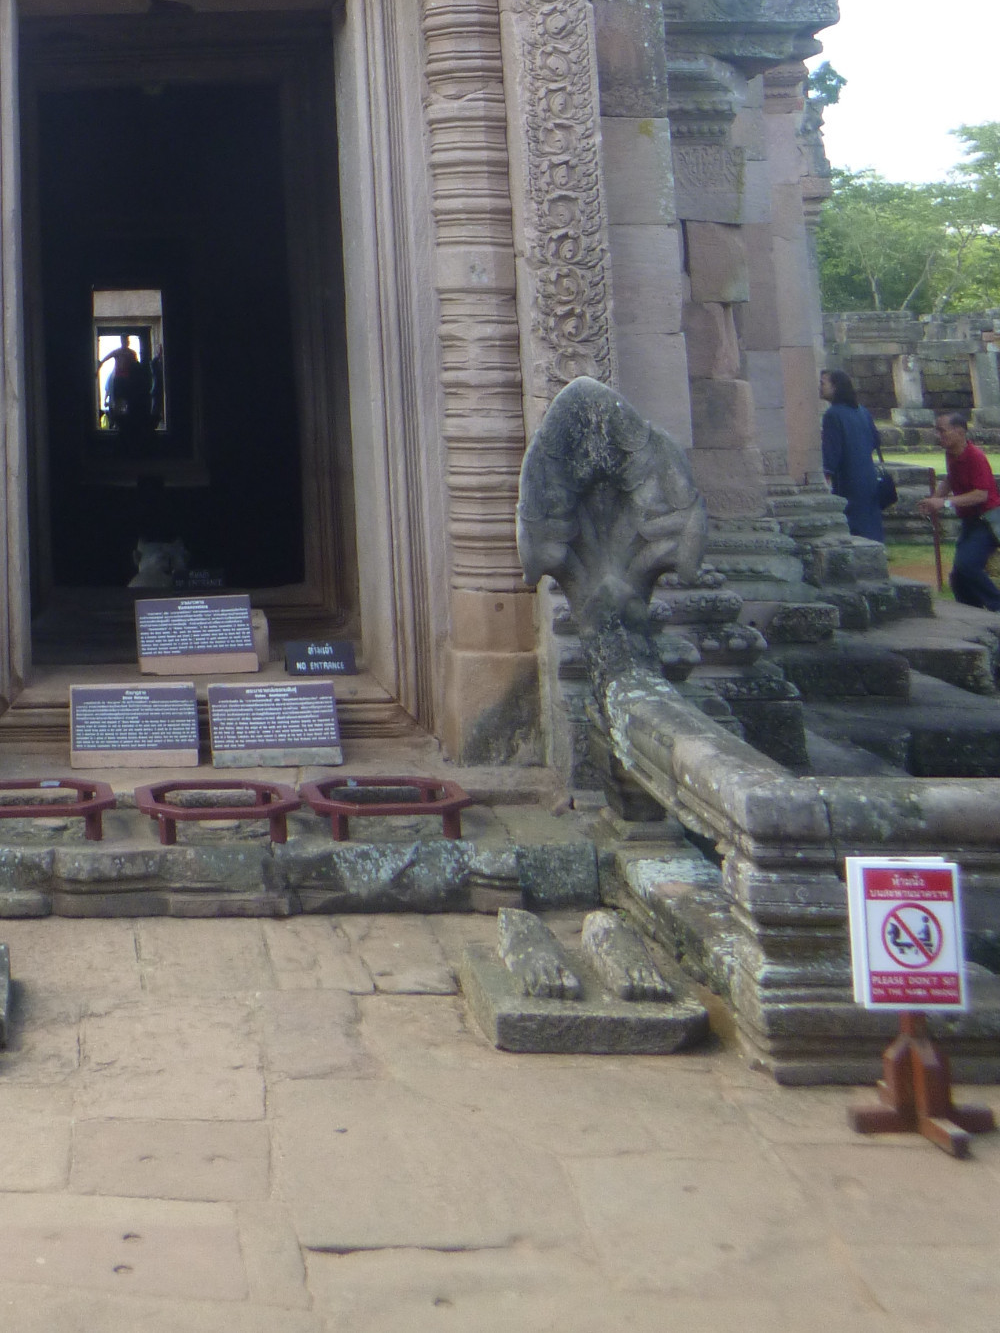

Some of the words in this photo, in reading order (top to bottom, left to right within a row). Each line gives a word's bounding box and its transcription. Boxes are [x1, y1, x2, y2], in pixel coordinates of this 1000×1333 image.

[296, 662, 306, 670] NO
[872, 976, 904, 984] PLEASE
[908, 976, 938, 984] DON'T
